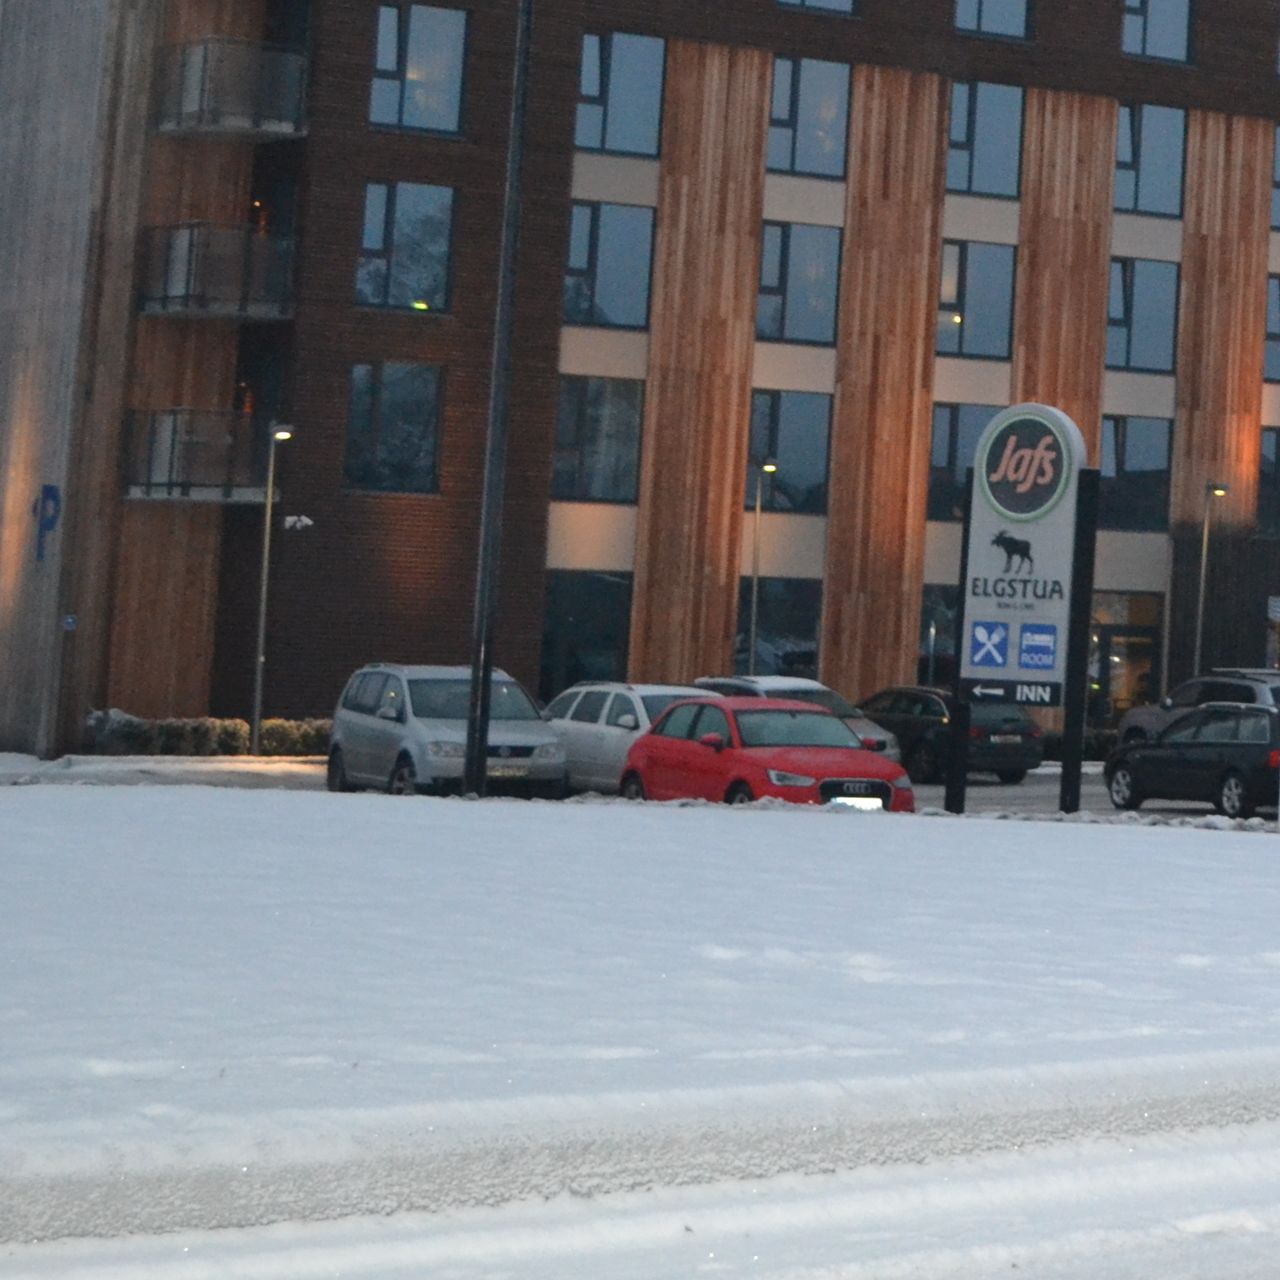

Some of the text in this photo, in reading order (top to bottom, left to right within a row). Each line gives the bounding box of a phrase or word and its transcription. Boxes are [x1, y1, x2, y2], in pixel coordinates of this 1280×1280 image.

[989, 434, 1056, 493] Jafs
[971, 577, 1064, 600] ELGSTUA
[1020, 653, 1054, 665] ROOM
[1015, 684, 1051, 703] INN
